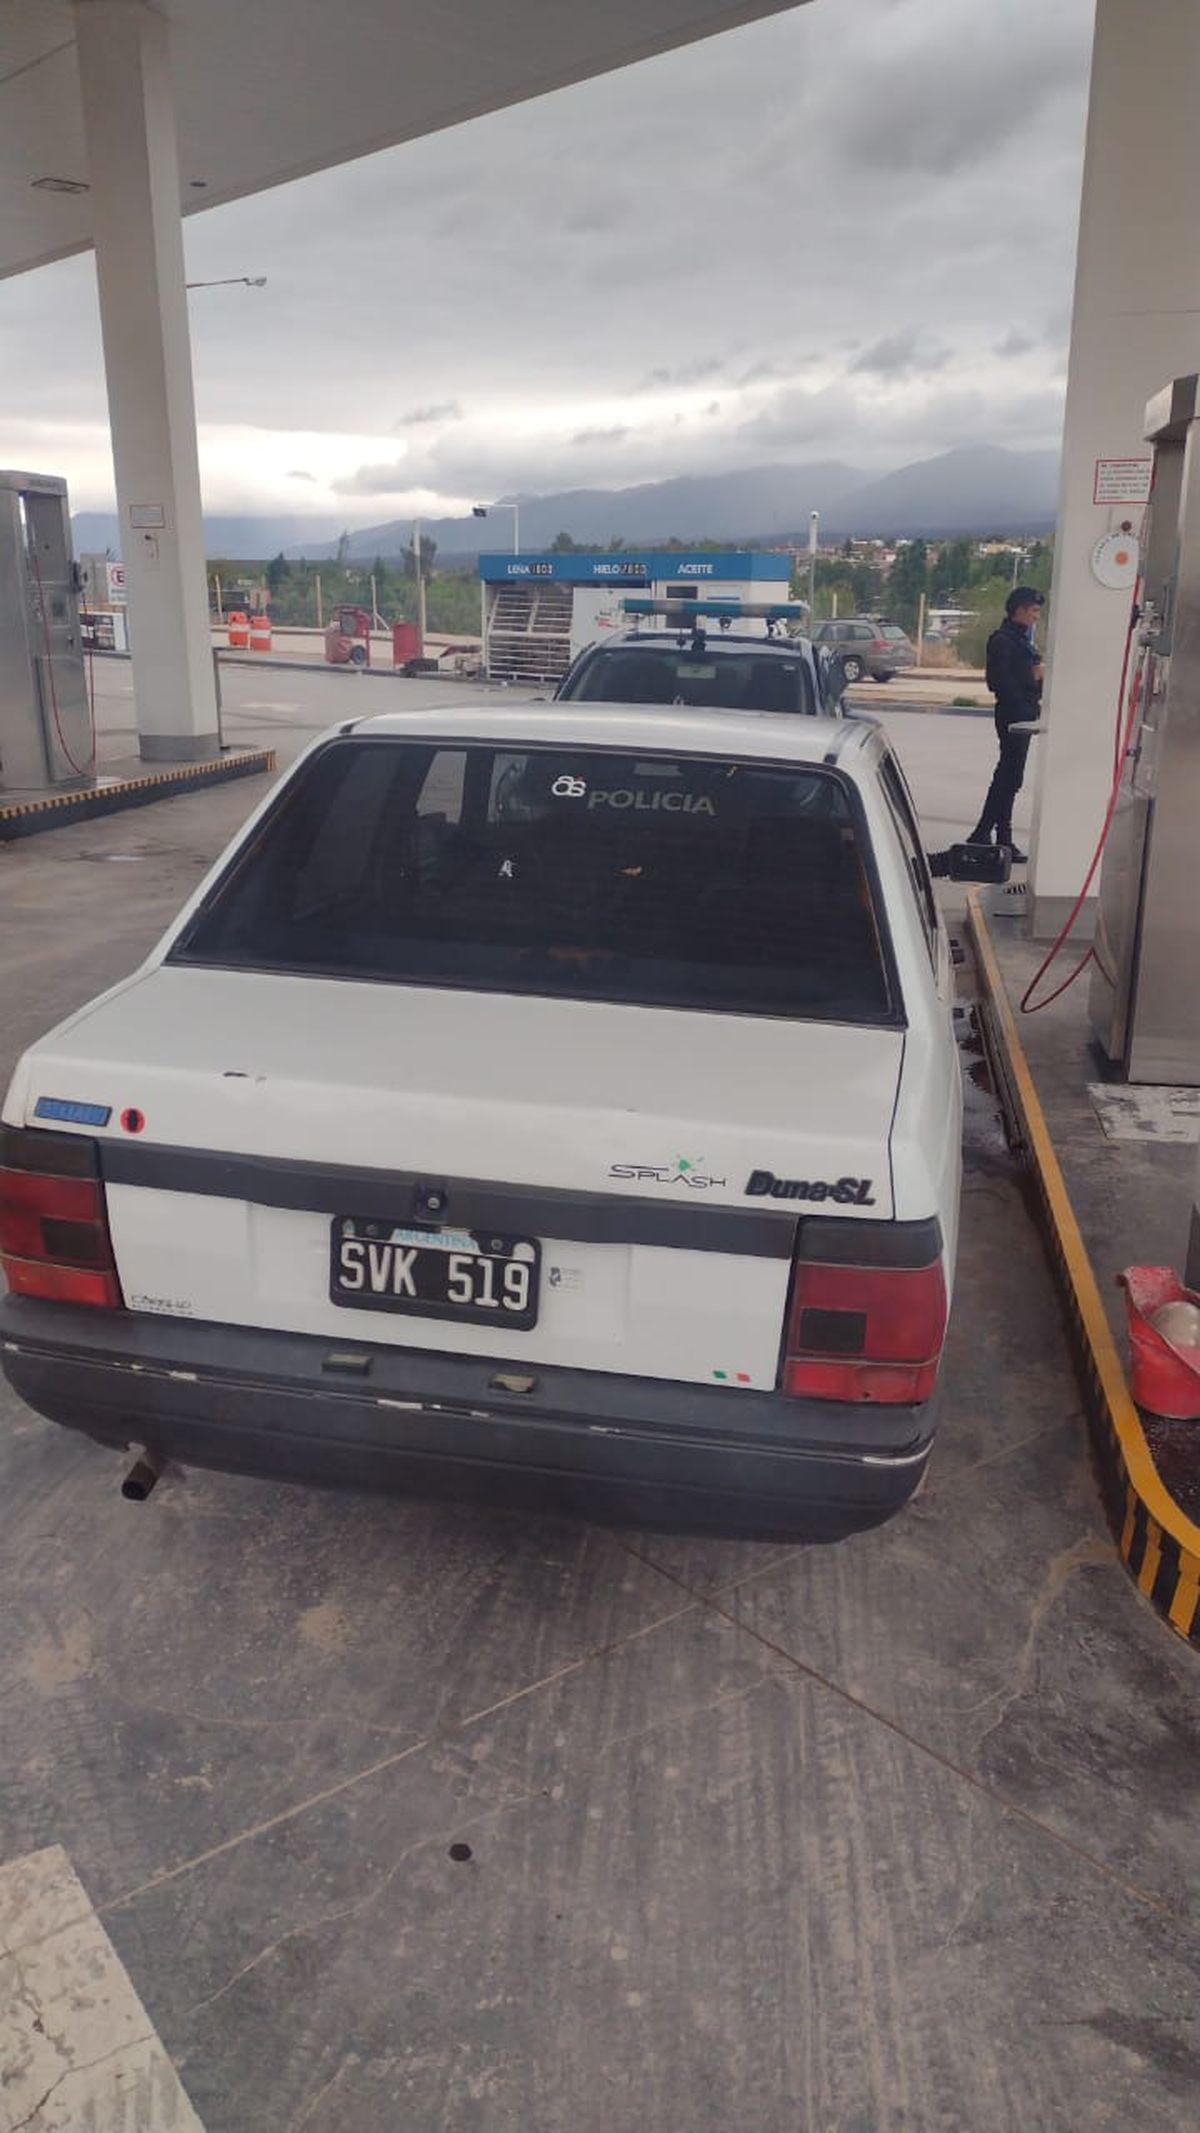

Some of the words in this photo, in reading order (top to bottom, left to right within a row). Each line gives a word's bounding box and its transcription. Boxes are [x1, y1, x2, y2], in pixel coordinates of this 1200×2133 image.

[677, 563, 714, 575] ACEITE
[587, 789, 717, 816] POLICIA
[608, 1163, 727, 1189] SPLASH
[338, 1240, 418, 1297] SVK
[447, 1252, 531, 1312] 519
